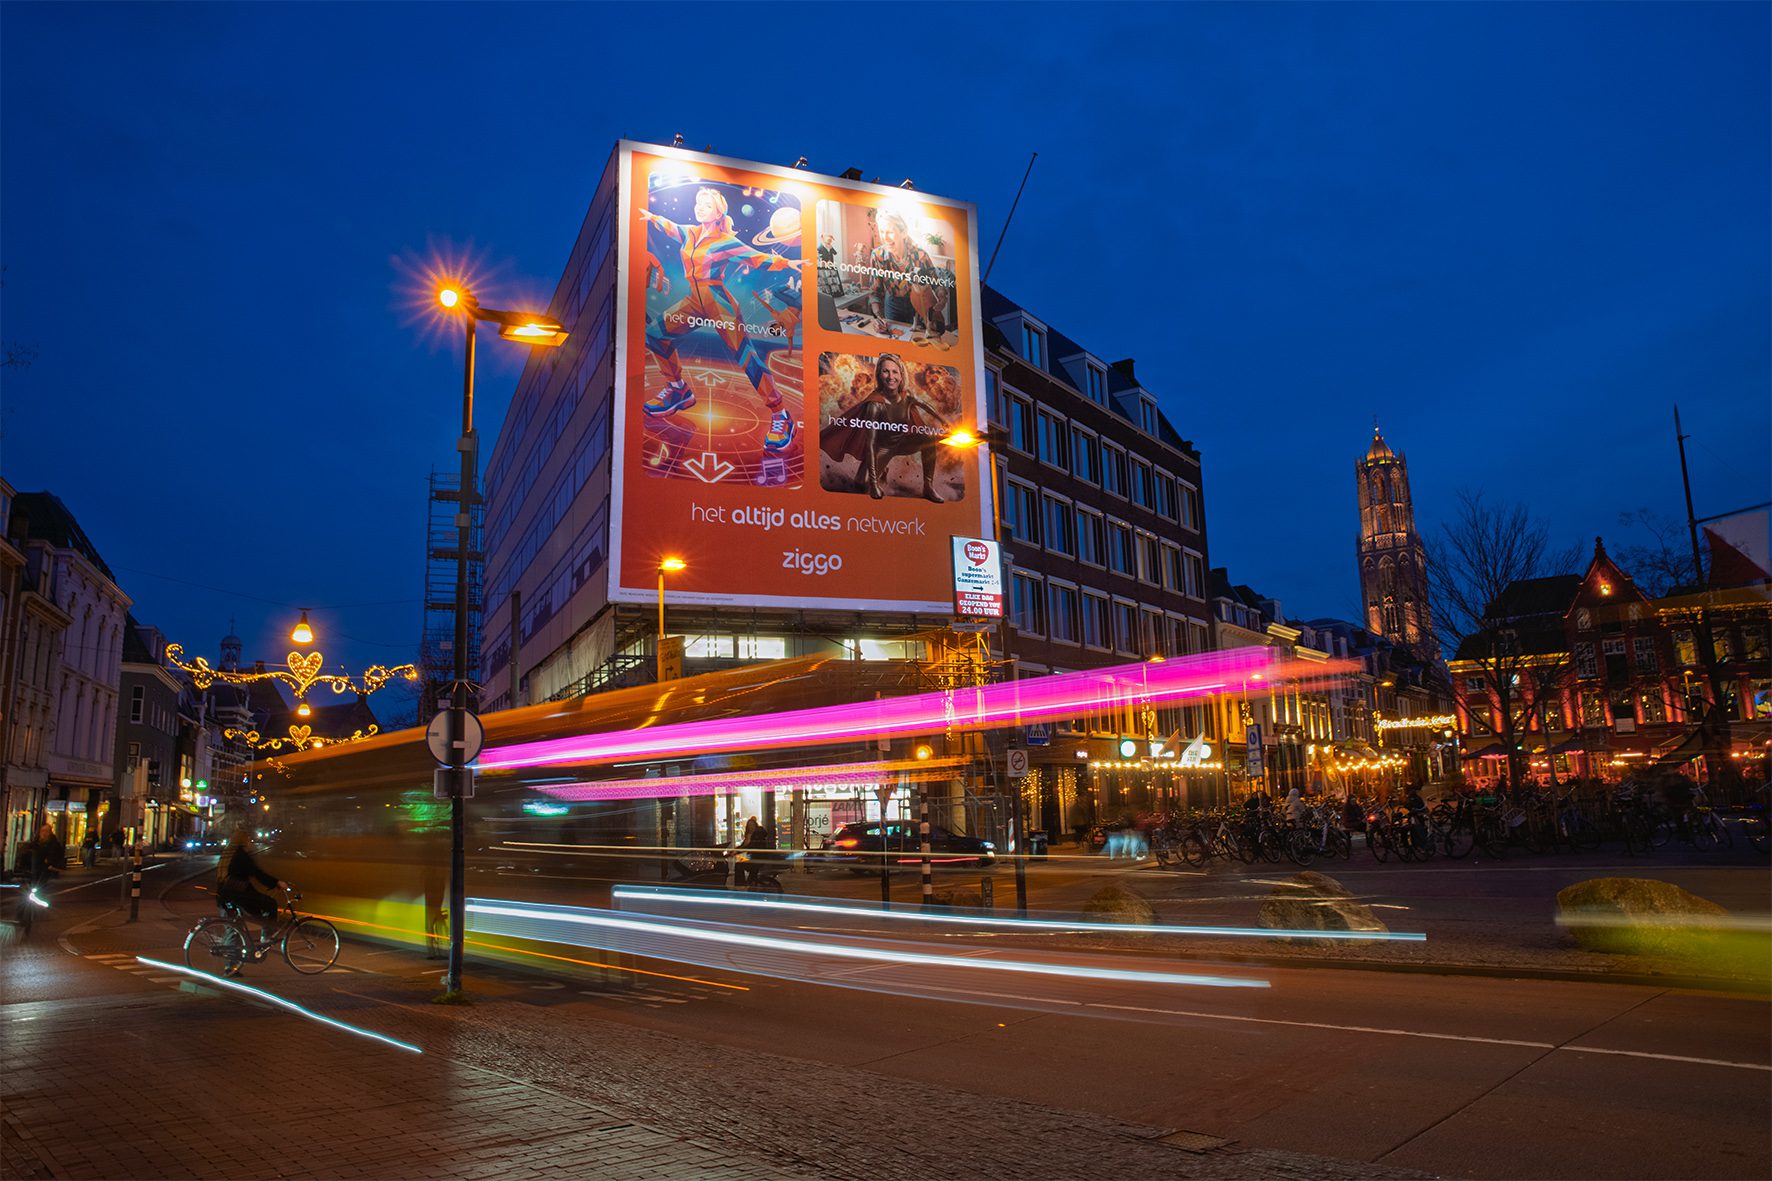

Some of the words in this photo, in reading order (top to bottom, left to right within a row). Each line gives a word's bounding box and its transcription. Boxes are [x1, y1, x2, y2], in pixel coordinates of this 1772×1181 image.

[820, 257, 837, 271] het
[839, 261, 912, 282] ondernemers
[912, 272, 955, 288] netwerk
[663, 310, 684, 325] het
[687, 313, 736, 330] gamers
[738, 321, 787, 337] netwerk
[828, 414, 848, 427] het
[849, 417, 909, 433] streamers
[692, 502, 725, 523] het
[732, 506, 785, 530] altijd
[790, 510, 842, 530] alles
[847, 517, 926, 535] netwerk
[782, 548, 843, 575] ziggo
[962, 606, 983, 614] 24.00
